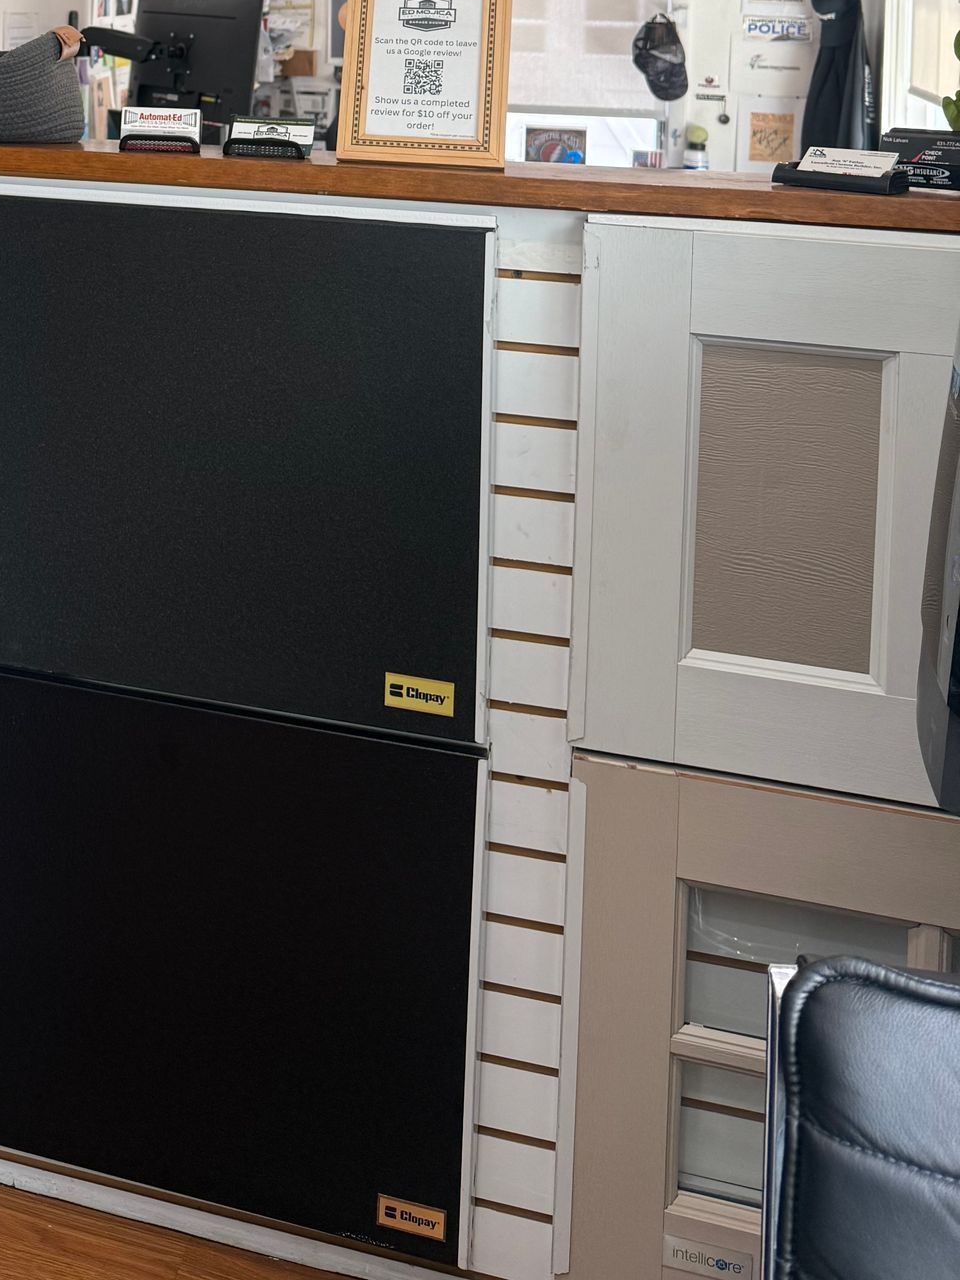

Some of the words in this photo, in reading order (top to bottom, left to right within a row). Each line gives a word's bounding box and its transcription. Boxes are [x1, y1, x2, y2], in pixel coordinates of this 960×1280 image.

[748, 23, 806, 35] POLICE
[411, 38, 422, 46] QR
[403, 48, 431, 57] Google
[375, 96, 399, 104] Show
[421, 99, 470, 108] completed
[370, 108, 400, 116] review
[402, 108, 415, 117] for
[417, 109, 434, 118] $10
[436, 111, 450, 119] off
[452, 113, 473, 121] your
[406, 122, 434, 130] order!
[406, 686, 446, 705] Clopay
[400, 1210, 437, 1230] Clopay
[672, 1245, 742, 1274] intellicore
